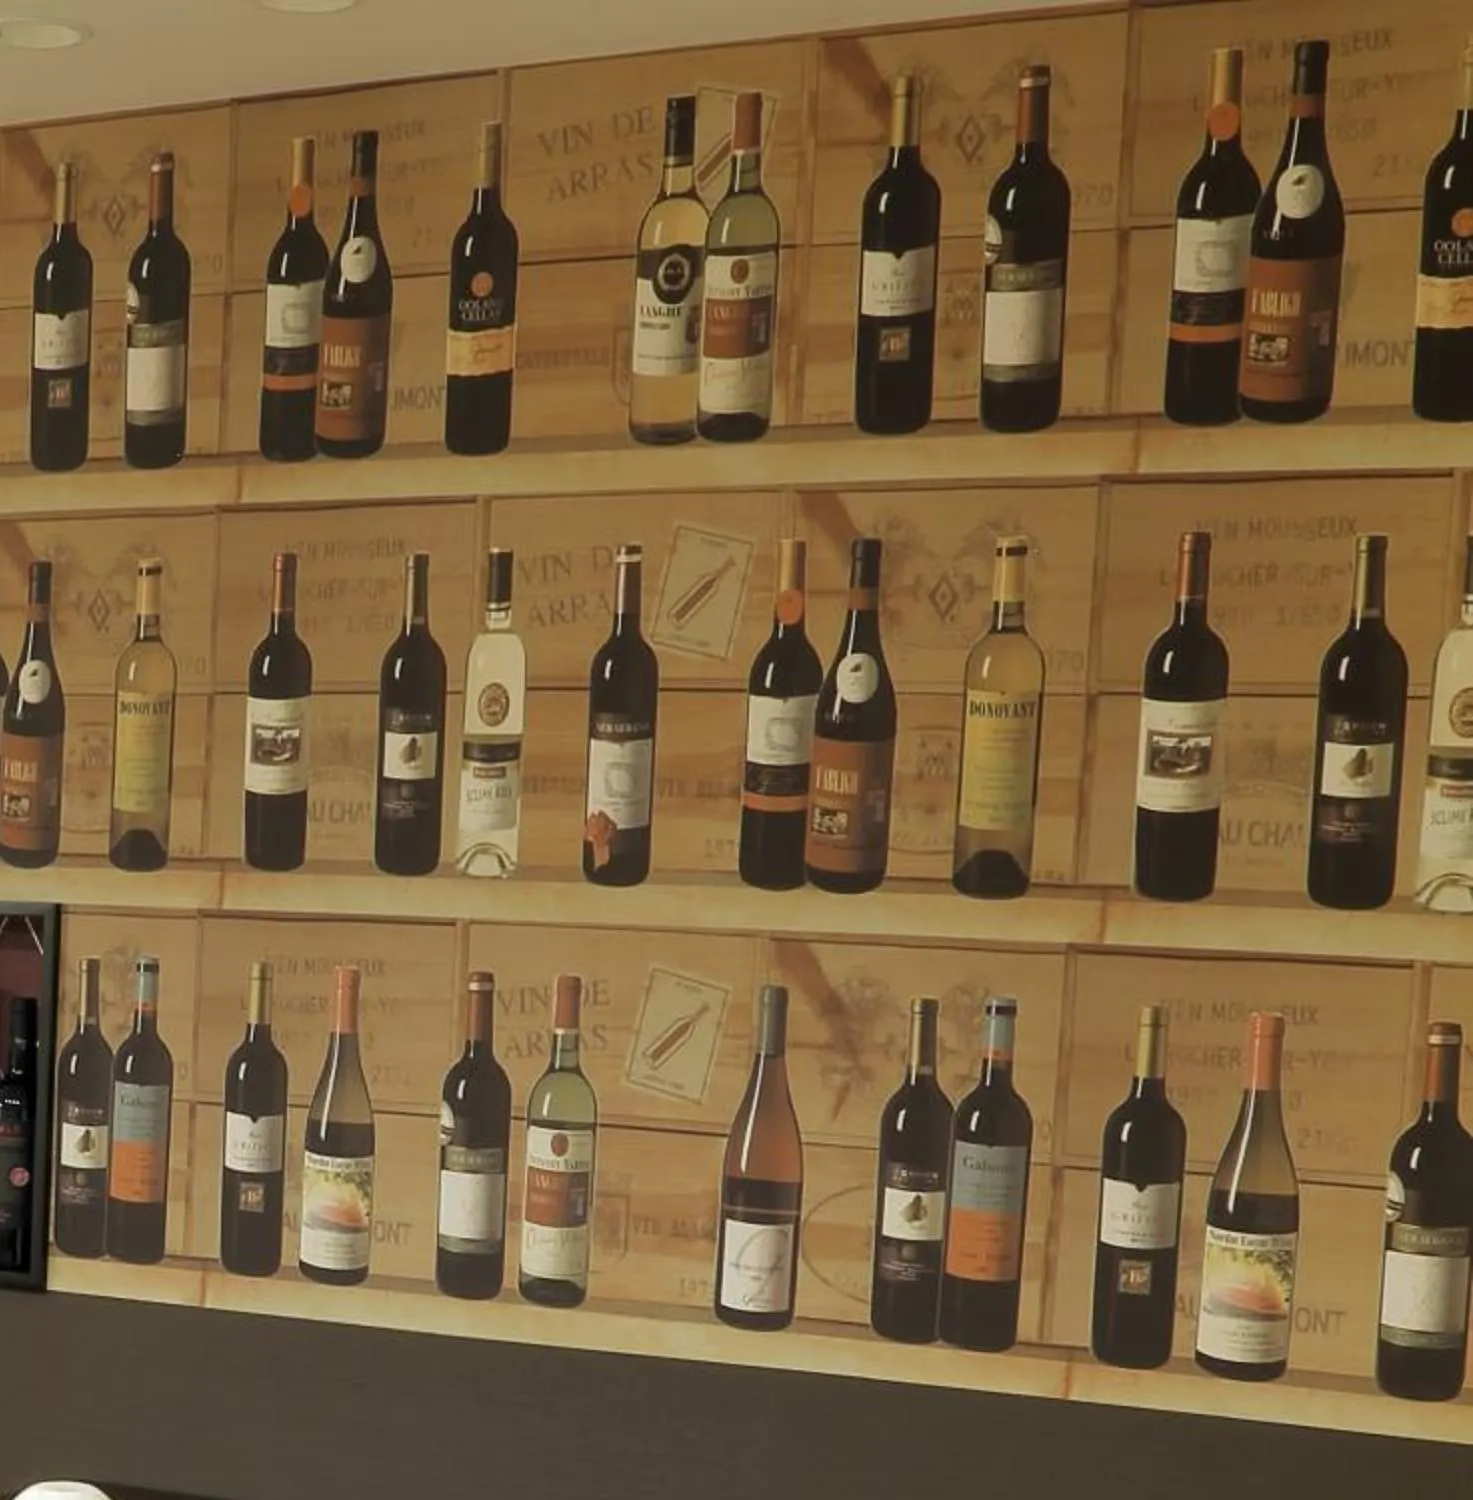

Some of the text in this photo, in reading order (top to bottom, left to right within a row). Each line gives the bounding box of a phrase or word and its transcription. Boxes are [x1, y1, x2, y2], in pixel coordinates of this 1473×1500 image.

[536, 105, 658, 158] VIN DE
[545, 152, 657, 204] ARRAS
[517, 543, 613, 585] VIN D
[523, 588, 614, 631] ARRA
[495, 984, 549, 1017] VIN
